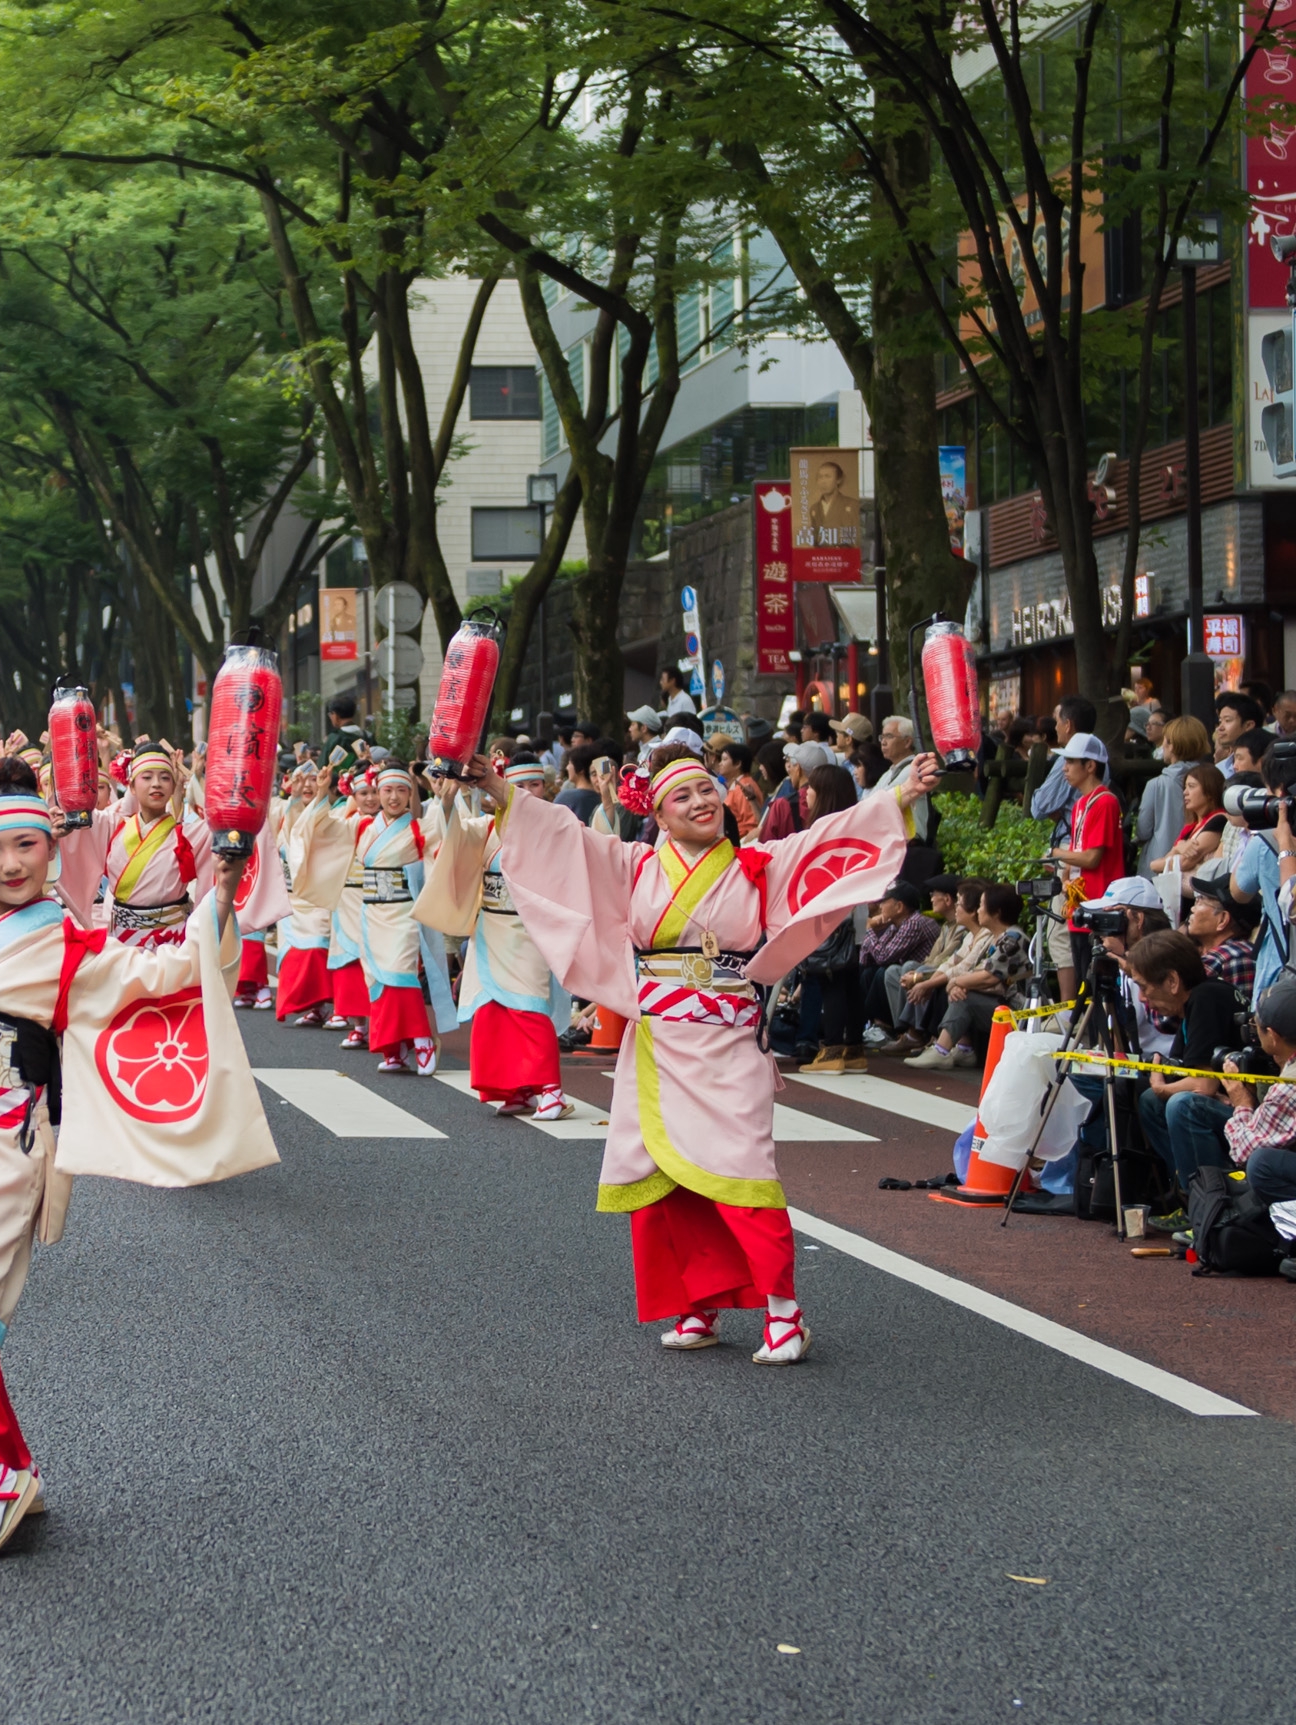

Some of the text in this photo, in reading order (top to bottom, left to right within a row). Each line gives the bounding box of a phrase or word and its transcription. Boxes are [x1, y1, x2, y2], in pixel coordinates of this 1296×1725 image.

[796, 525, 838, 546] 高知
[764, 561, 789, 615] 遊茶
[768, 655, 786, 664] TEA
